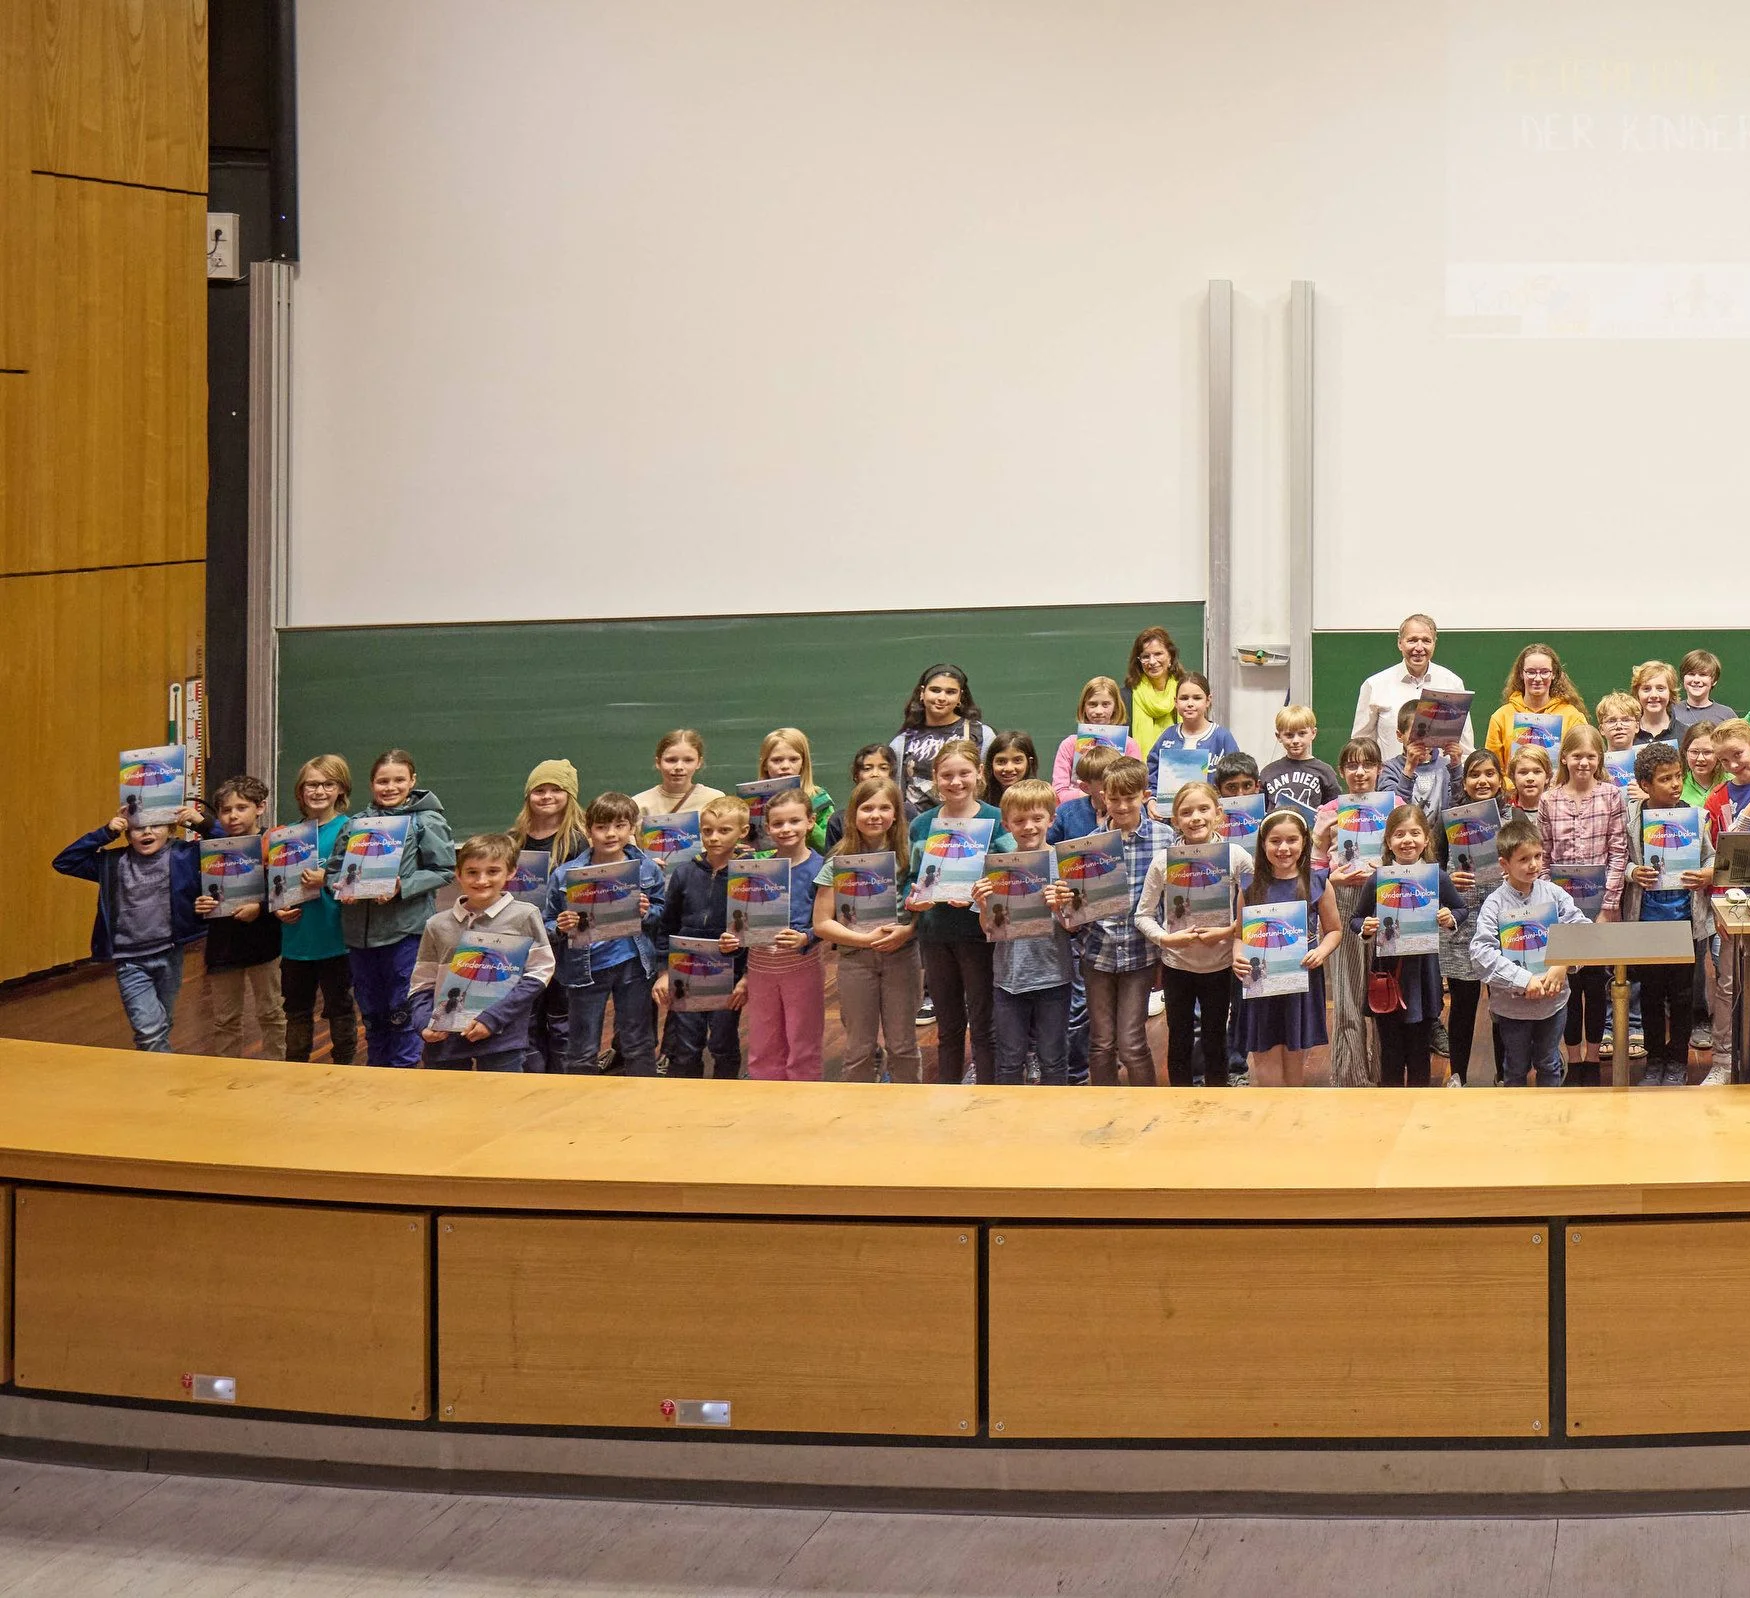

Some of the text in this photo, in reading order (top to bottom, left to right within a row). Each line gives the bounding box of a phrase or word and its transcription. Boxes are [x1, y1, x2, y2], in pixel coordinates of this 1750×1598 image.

[1520, 113, 1593, 152] DER
[1266, 773, 1290, 794] SAN
[1648, 831, 1696, 840] Kinderuni-Diplom
[351, 838, 401, 848] Kinderuni-Diplom
[1171, 869, 1226, 879] Kinderuni-Diplom
[1382, 890, 1435, 900] Kinderuni-Diplom
[1248, 928, 1303, 939] Kinderuni-Diplom
[457, 960, 519, 972] Kinderuni-Diplom
